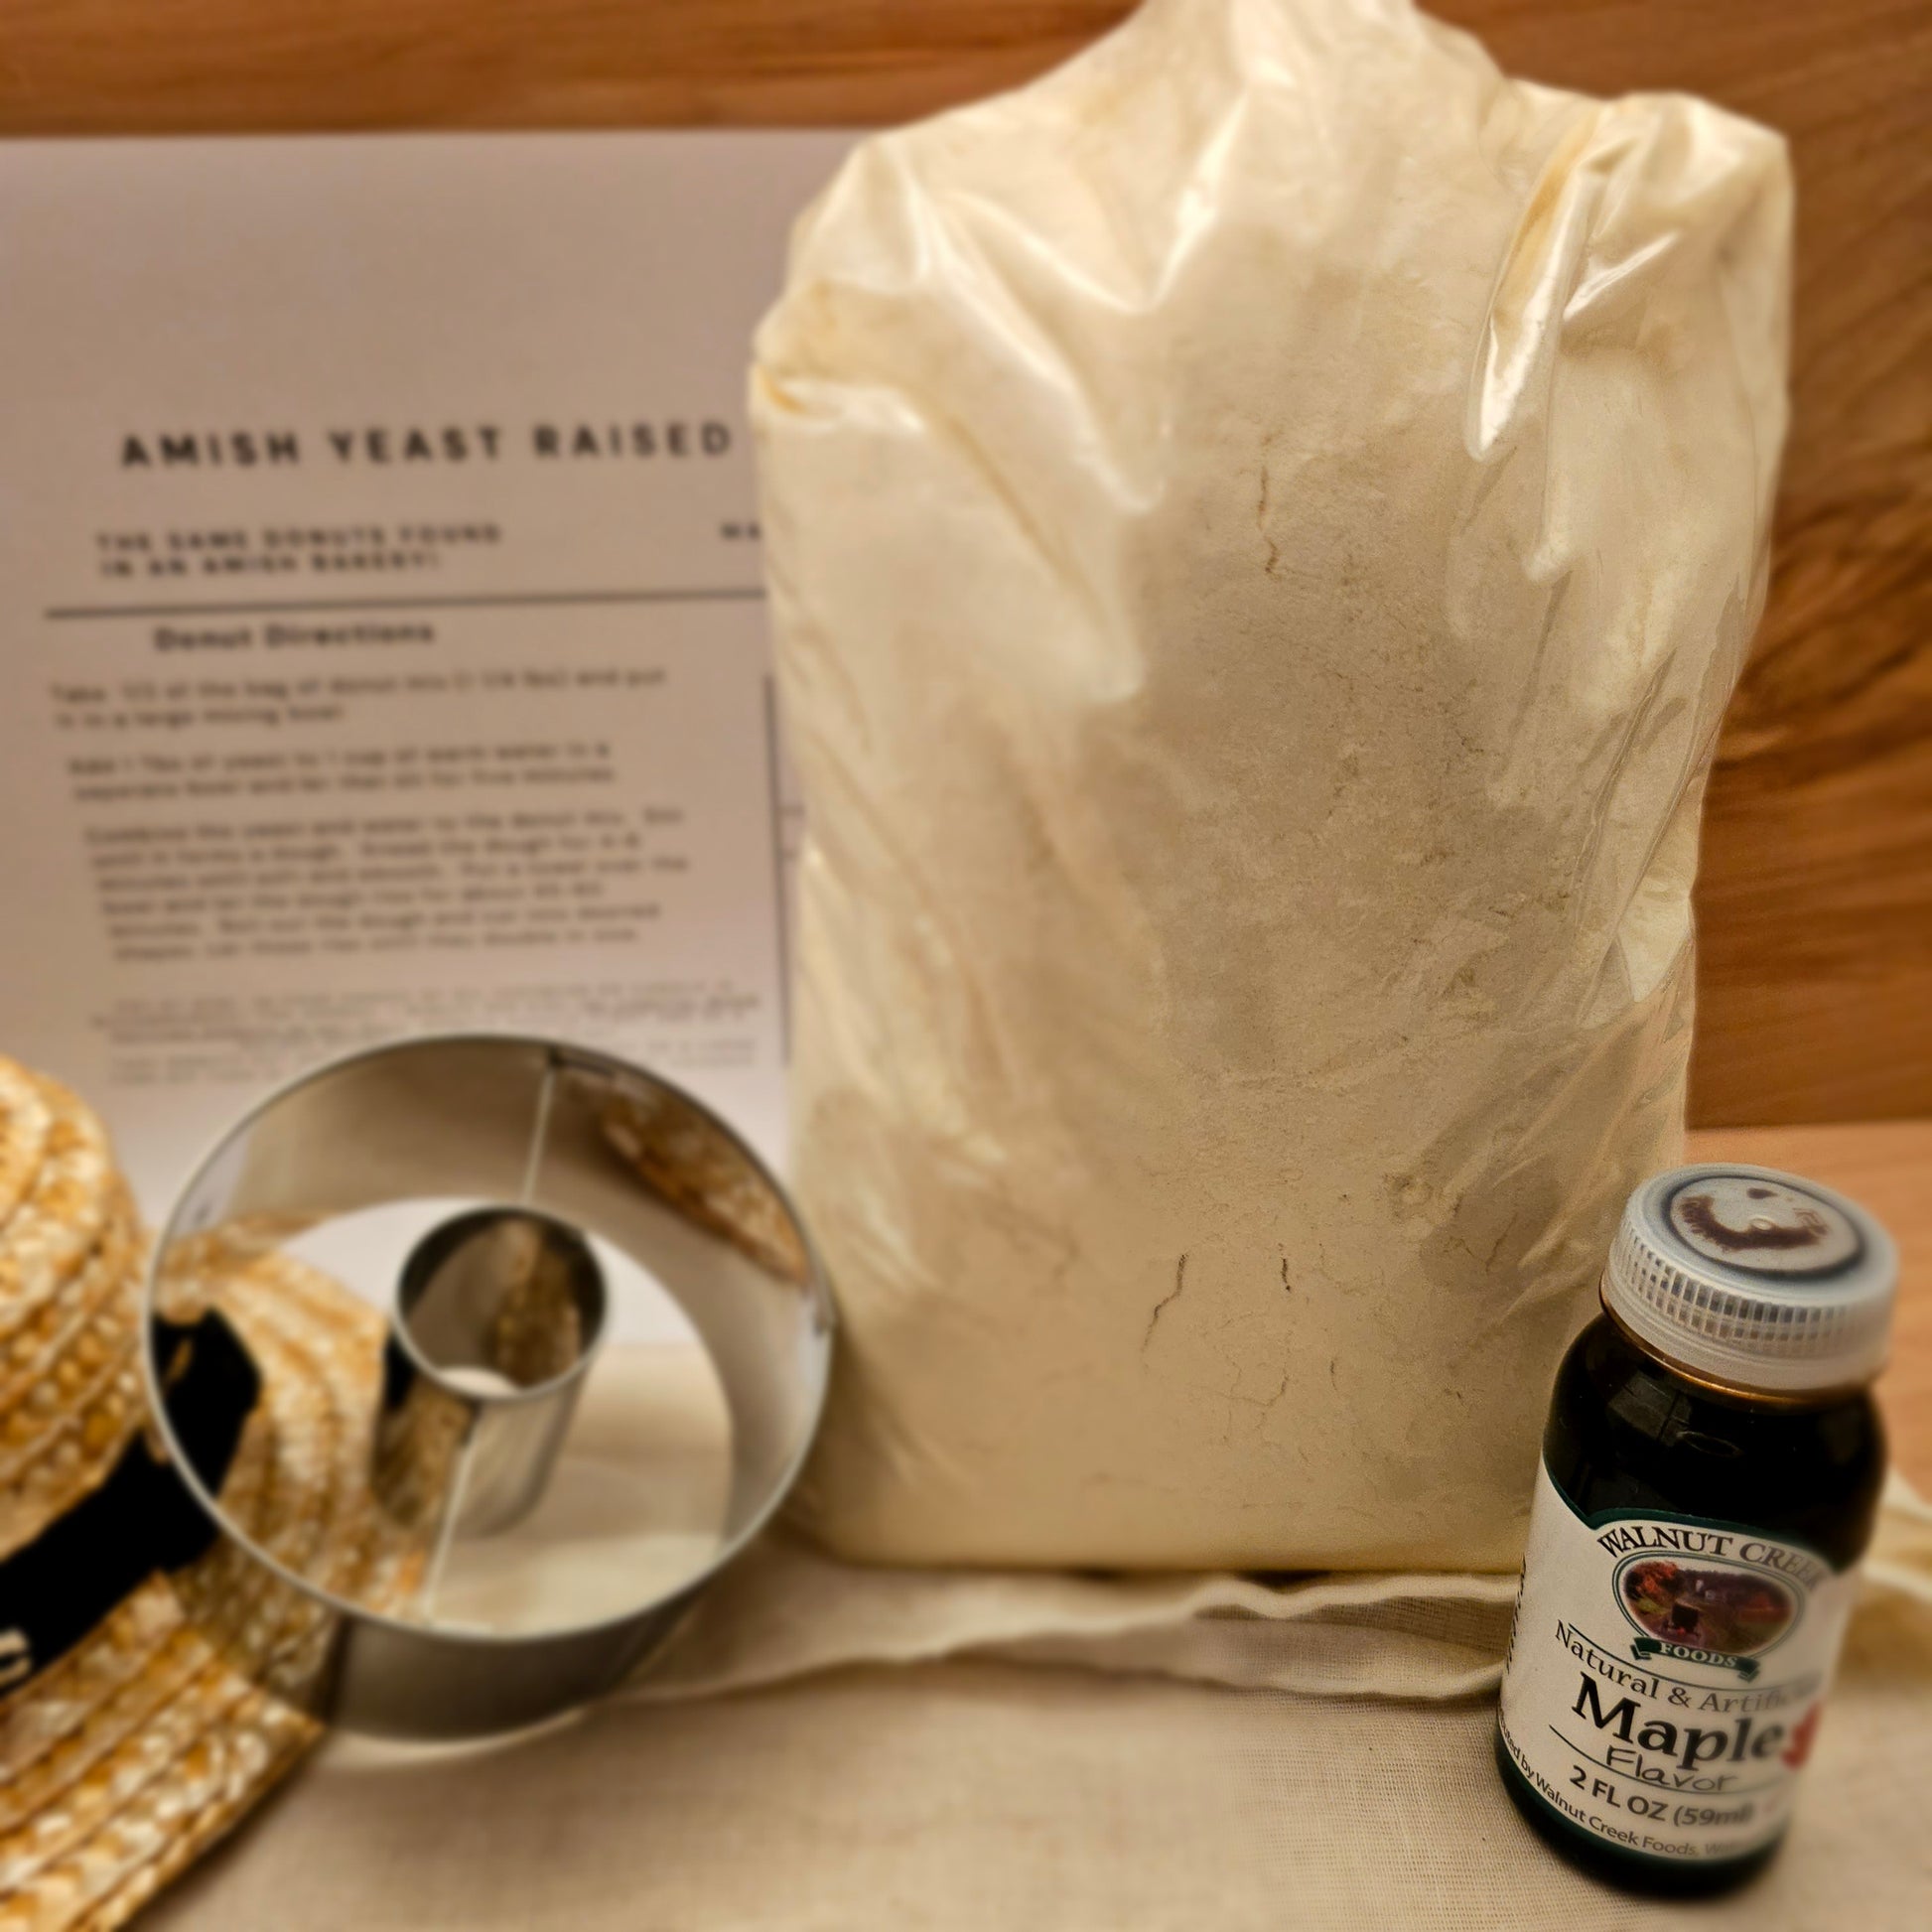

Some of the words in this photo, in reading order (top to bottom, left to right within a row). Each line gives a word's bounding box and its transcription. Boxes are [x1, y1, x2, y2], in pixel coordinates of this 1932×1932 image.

[120, 430, 301, 469] AMISH
[328, 427, 504, 465] YEAST
[533, 423, 735, 460] RAISED
[154, 627, 252, 652] Donut
[265, 623, 435, 648] Directions
[1596, 1525, 1734, 1559] WALNUT
[1555, 1618, 1660, 1701] Natural
[1667, 1685, 1692, 1709] &
[1660, 1641, 1737, 1669] FOODS
[1571, 1671, 1784, 1771] Maple
[1604, 1743, 1738, 1792] Flavor
[1520, 1754, 1536, 1780] by
[1535, 1771, 1587, 1824] Walnut
[1587, 1815, 1640, 1847] Creek
[1569, 1763, 1587, 1791] 2
[1590, 1777, 1621, 1809] FL
[1626, 1794, 1669, 1823] OZ
